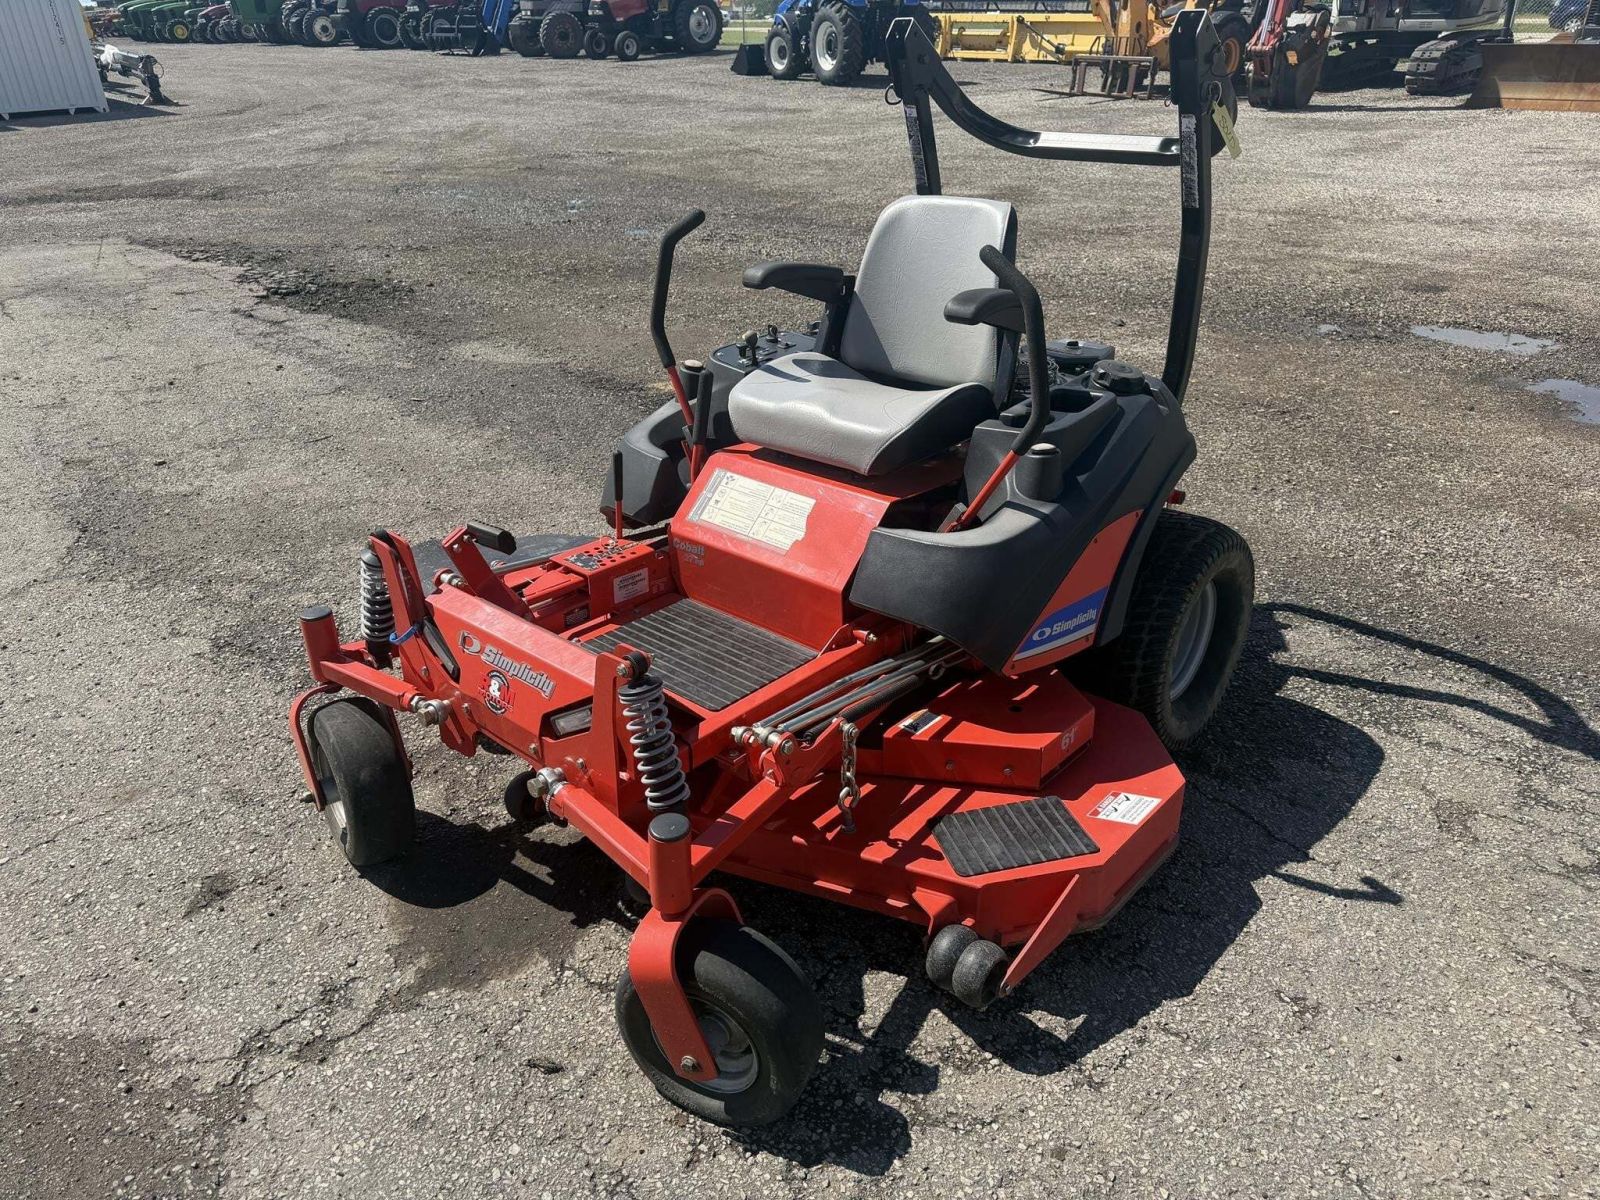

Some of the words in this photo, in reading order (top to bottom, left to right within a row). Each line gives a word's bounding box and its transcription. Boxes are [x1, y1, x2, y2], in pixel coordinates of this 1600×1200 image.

[673, 537, 705, 555] Cobalt
[1052, 609, 1097, 635] Simplicity
[481, 644, 557, 701] Simplicity
